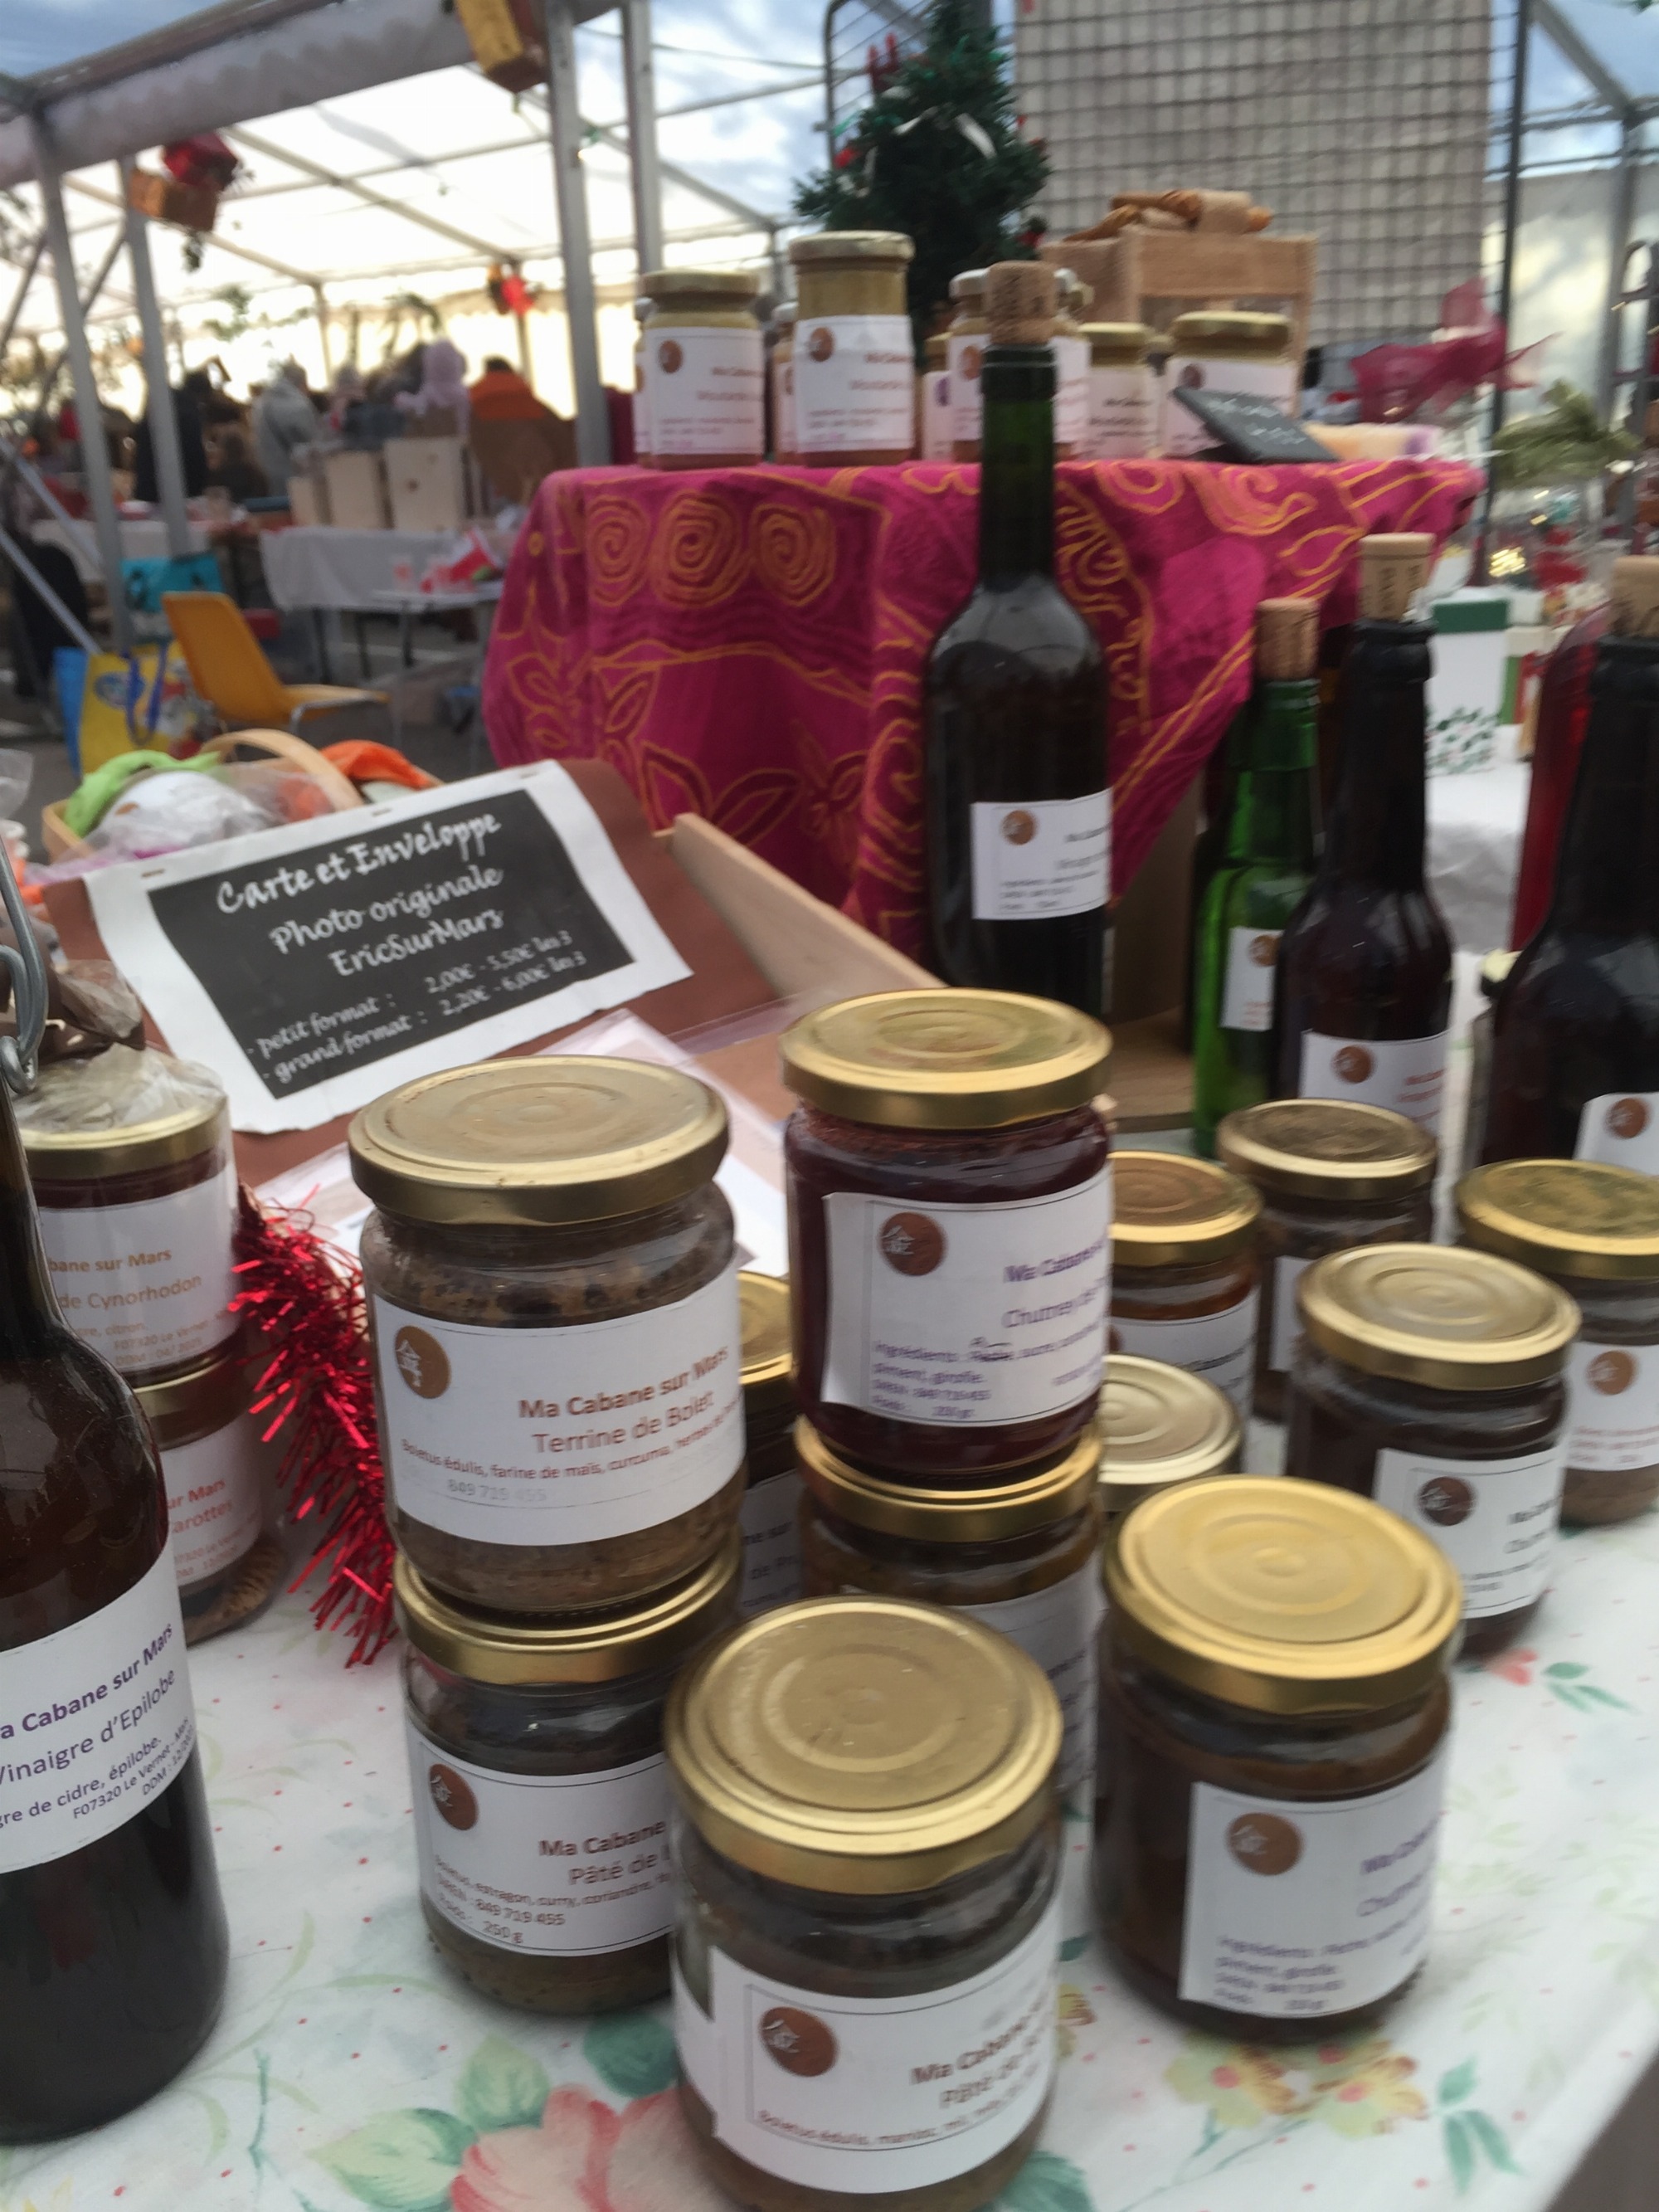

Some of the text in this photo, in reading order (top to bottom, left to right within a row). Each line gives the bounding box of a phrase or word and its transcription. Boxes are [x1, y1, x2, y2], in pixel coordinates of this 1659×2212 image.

[216, 814, 501, 914] Carte et Enveloppe
[269, 865, 504, 954] Photo originale
[255, 1020, 310, 1060] petit
[308, 996, 380, 1037] format
[275, 1037, 344, 1084] grand
[342, 1014, 412, 1055] format
[49, 1249, 173, 1272] bane sur Mars
[59, 1275, 202, 1310] de Cynorhodon
[518, 1398, 561, 1419] Ma
[567, 1391, 655, 1415] Cabane
[659, 1372, 690, 1396] sur
[532, 1428, 626, 1454] Terrine
[631, 1416, 662, 1439] de
[490, 1464, 537, 1479] farine
[540, 1466, 561, 1479] de
[167, 1495, 184, 1509] ur
[173, 1499, 232, 1533] arottes
[0, 1623, 173, 1740] a Cabane sur Mars
[28, 1801, 52, 1817] de
[56, 1779, 105, 1807] cidre,
[73, 1786, 122, 1819] F07320
[124, 1776, 137, 1791] Le
[538, 1821, 666, 1857] Ma Cabane
[627, 1854, 658, 1873] de
